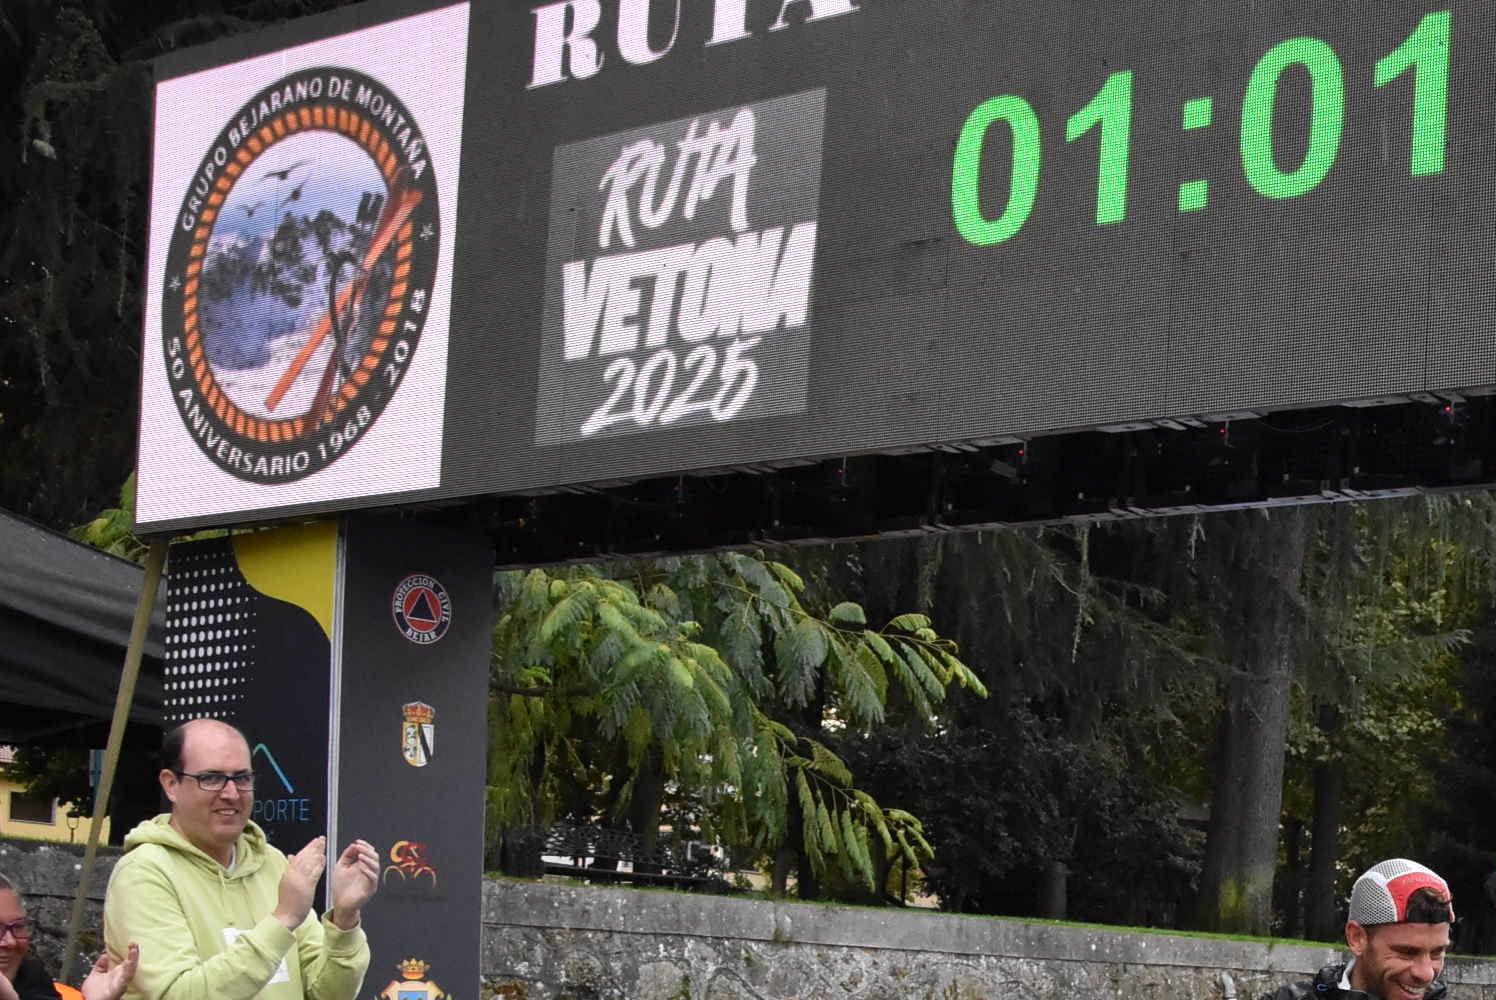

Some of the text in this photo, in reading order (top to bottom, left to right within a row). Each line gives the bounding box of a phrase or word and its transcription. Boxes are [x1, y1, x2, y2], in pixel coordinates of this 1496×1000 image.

[182, 75, 425, 232] GRUPO BEJARANO DE MONTAÑA
[599, 105, 758, 249] RUTA
[562, 222, 818, 360] VETONA
[167, 288, 425, 475] 50 ANIVERSARIO 1968 2018
[580, 336, 760, 436] 2025
[253, 798, 312, 823] PORTE
